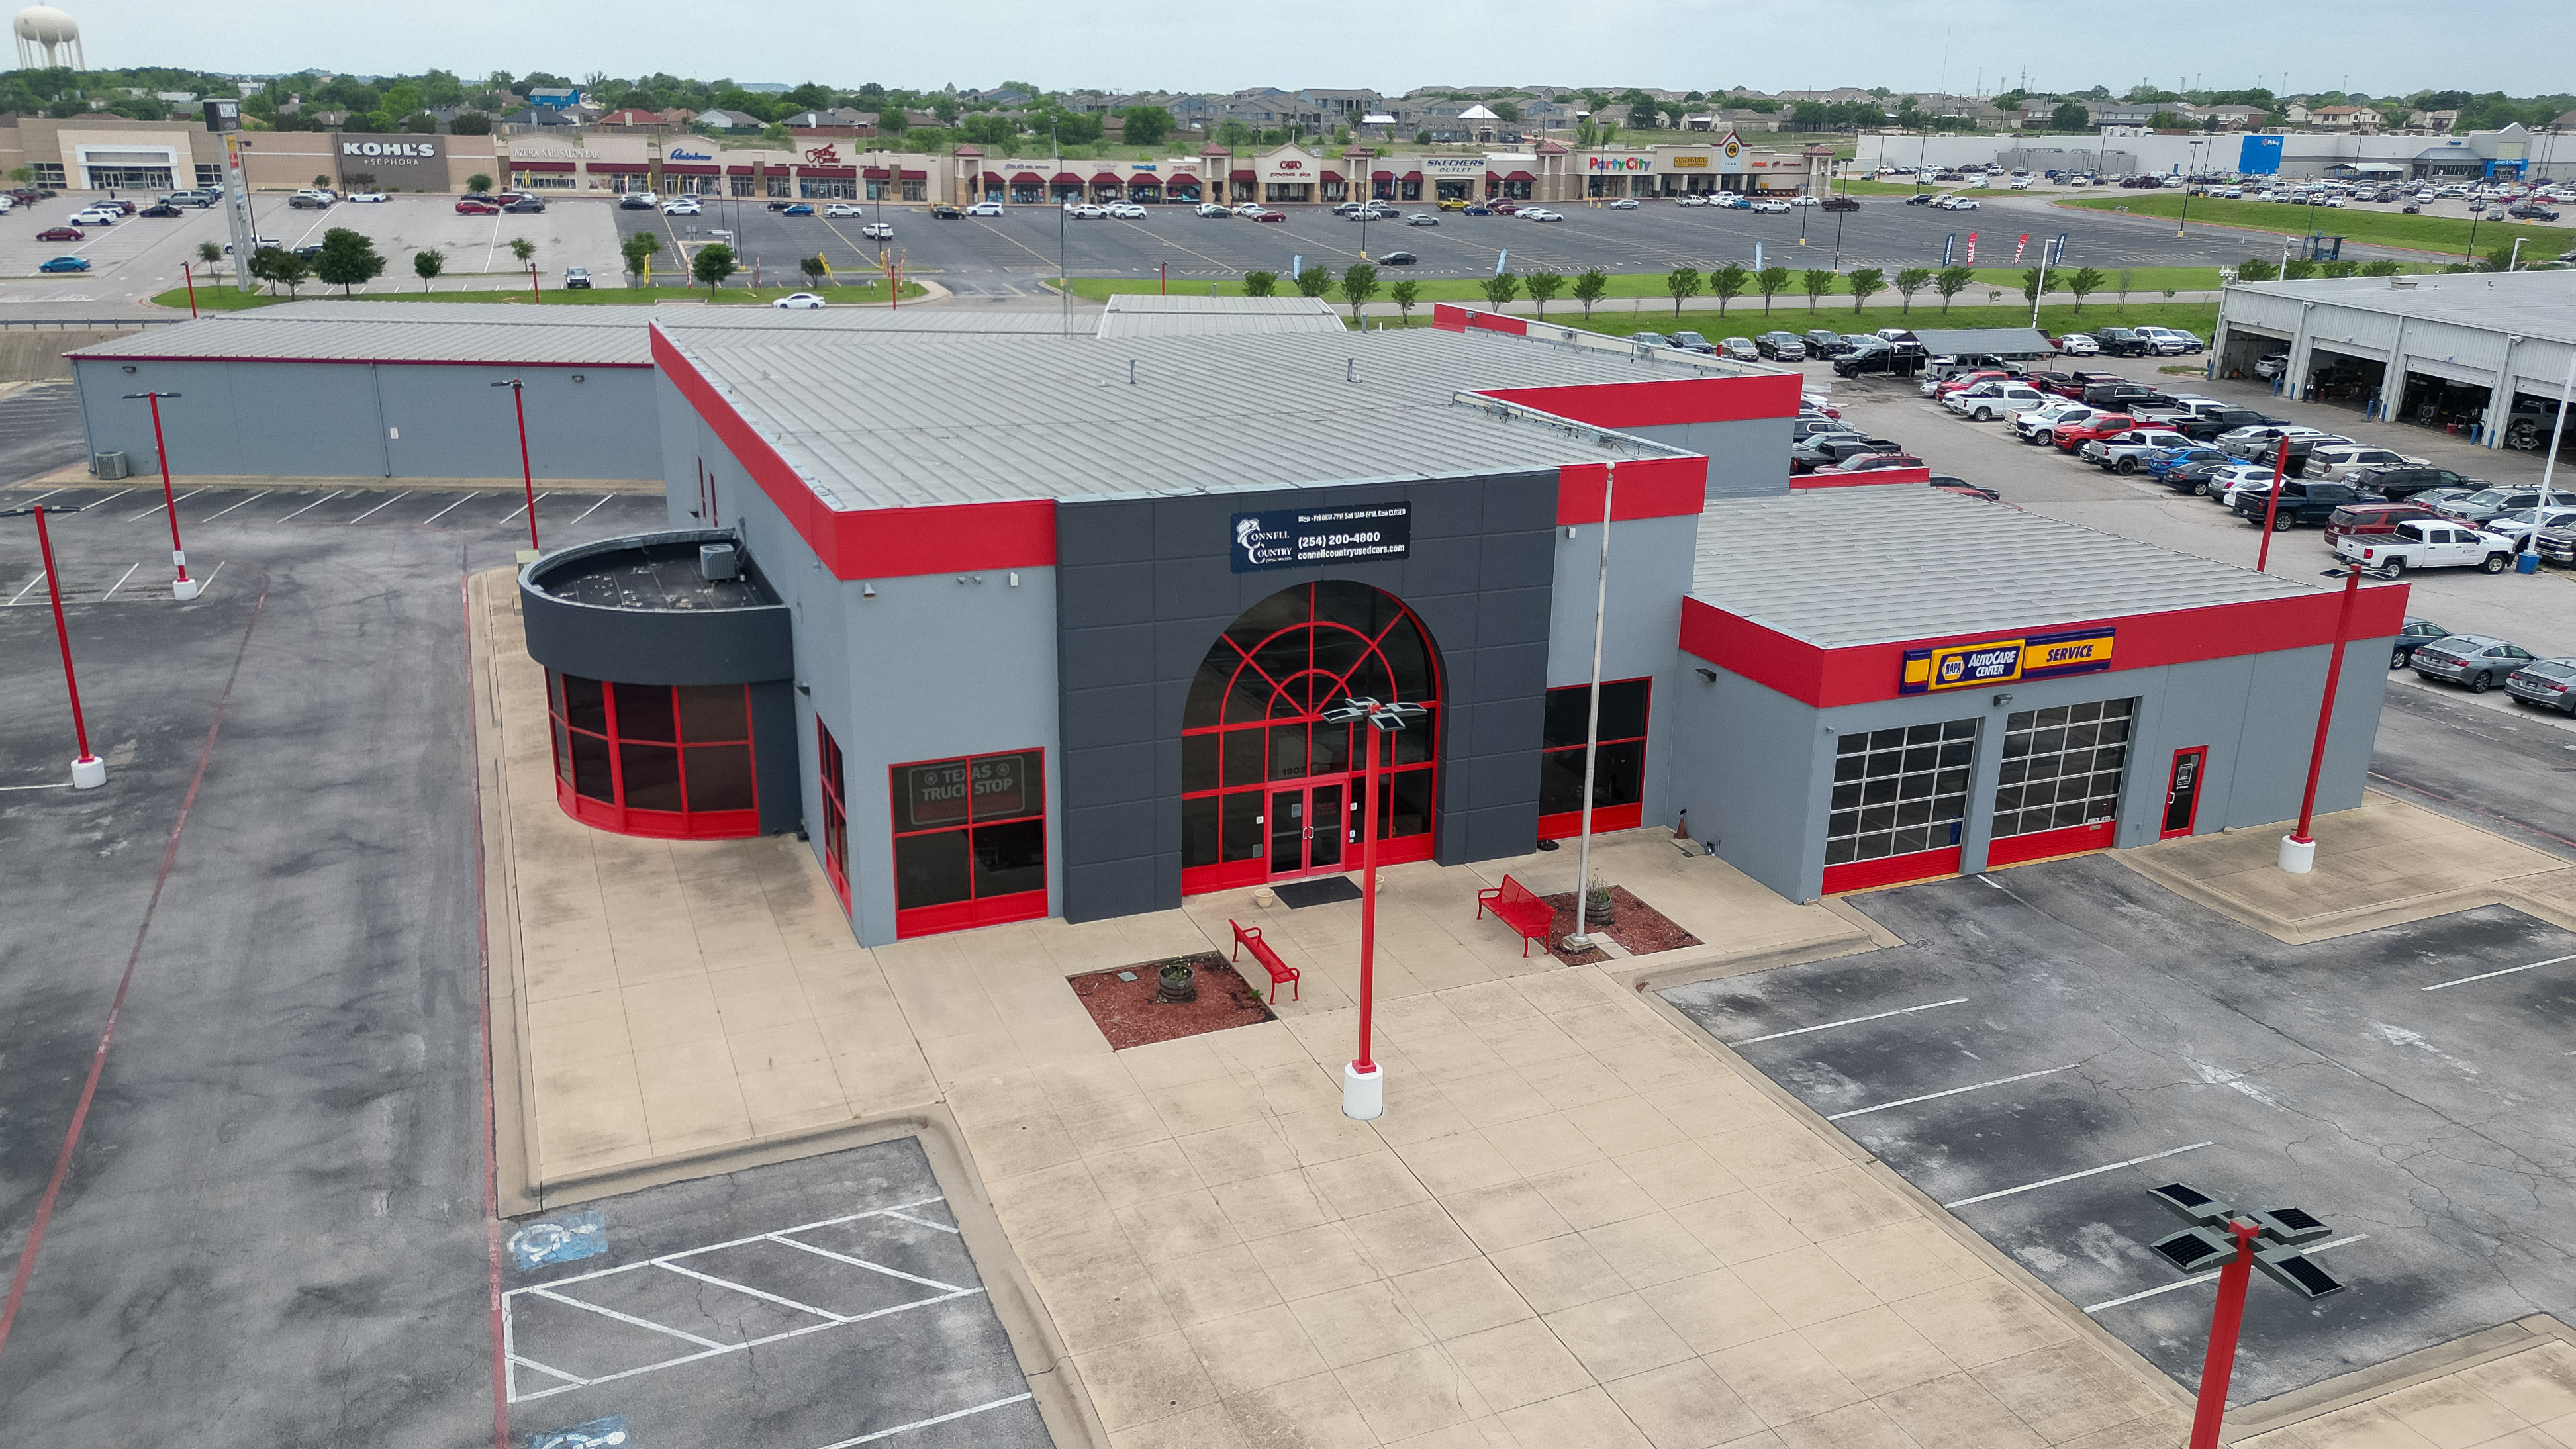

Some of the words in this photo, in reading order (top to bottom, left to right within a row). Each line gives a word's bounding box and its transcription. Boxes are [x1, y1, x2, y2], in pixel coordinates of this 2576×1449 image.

[343, 142, 435, 157] KOHL'S
[514, 148, 539, 158] AZURA
[542, 148, 559, 158] NAIL
[560, 148, 583, 158] SALON
[585, 149, 600, 159] BAR
[669, 148, 712, 160] Rainbow
[1280, 160, 1302, 169] CATO
[1298, 535, 1326, 549] (254)
[1329, 531, 1380, 545] 200-4800
[1298, 544, 1405, 561] connellcountryusedcars.com
[2046, 644, 2094, 663] SERVICE
[1945, 662, 1962, 675] NAPA
[1976, 664, 2005, 677] CENTER
[975, 778, 1013, 794] STOP
